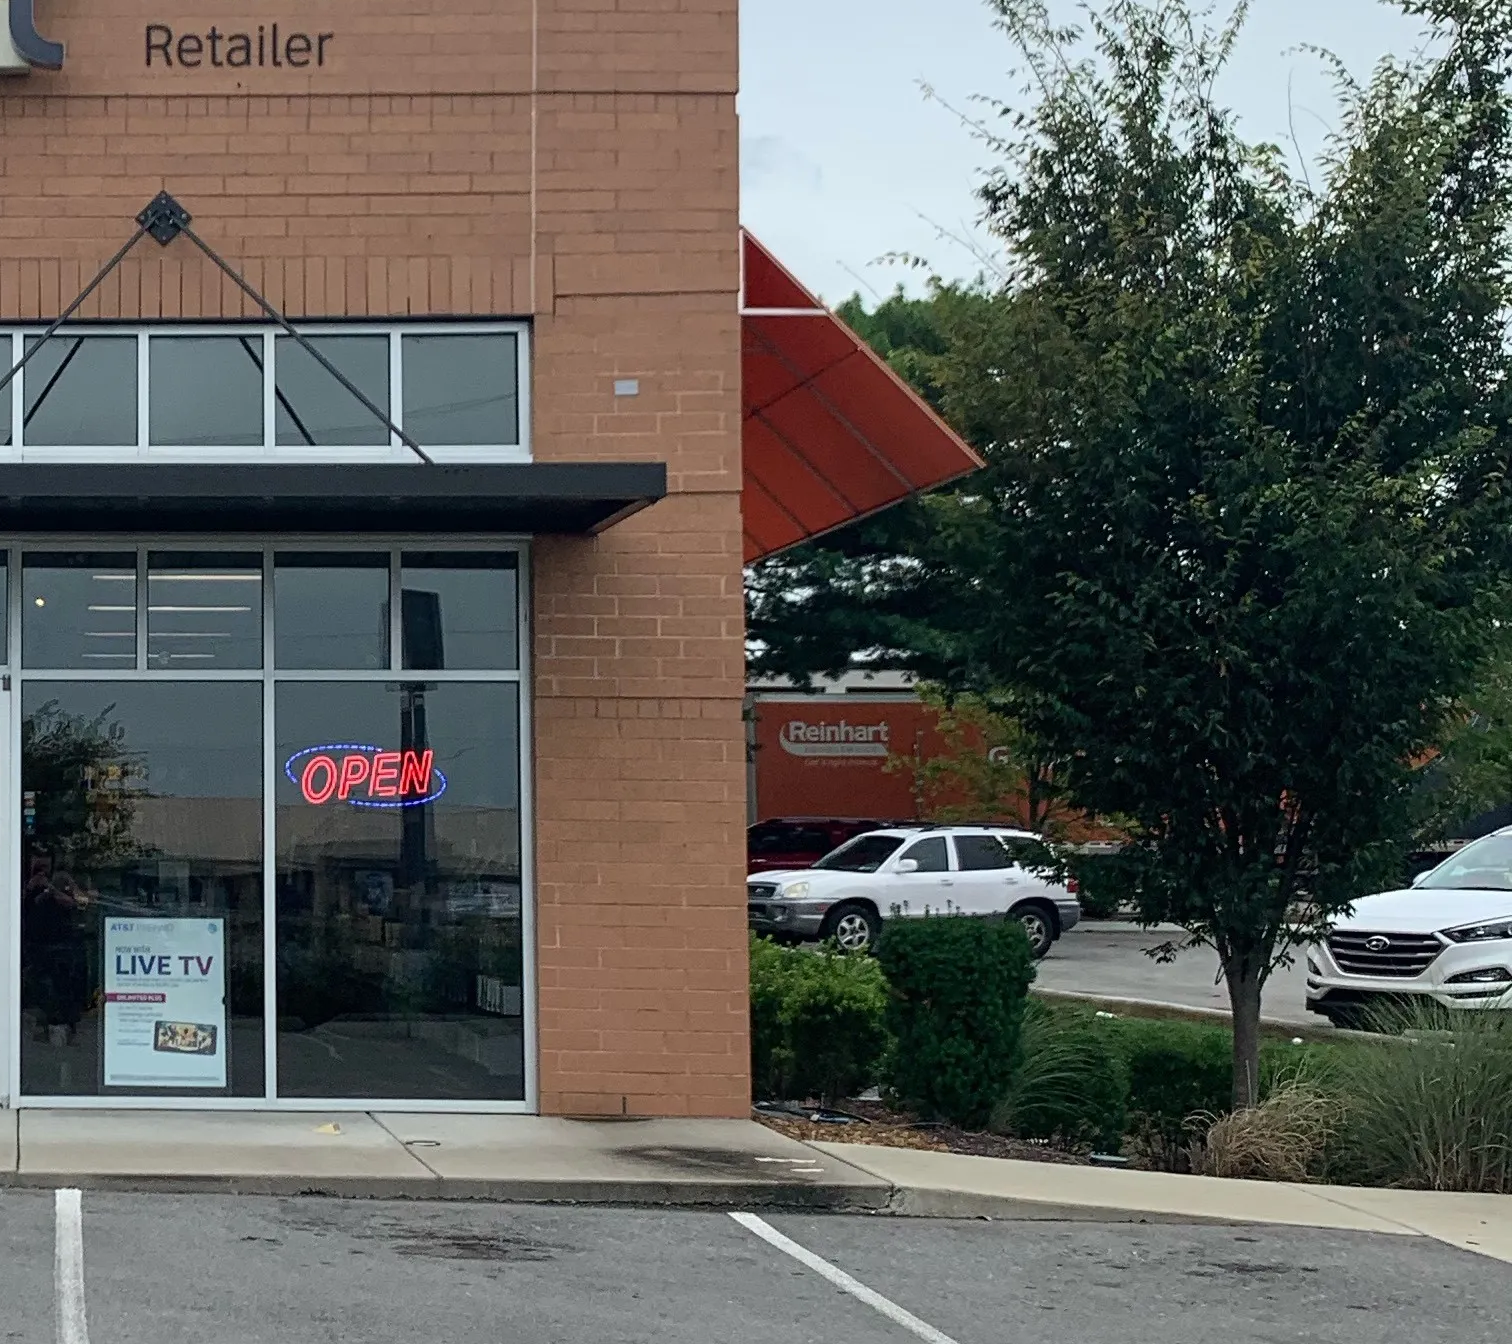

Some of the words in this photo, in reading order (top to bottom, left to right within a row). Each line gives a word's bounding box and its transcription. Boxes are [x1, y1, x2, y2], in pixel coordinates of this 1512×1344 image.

[142, 22, 334, 68] Retailer
[789, 721, 889, 742] Reinhart
[301, 750, 434, 805] OPEN
[111, 923, 134, 932] AT&T
[116, 955, 172, 975] LIVE
[178, 956, 214, 976] TV
[148, 994, 163, 1002] PLUS
